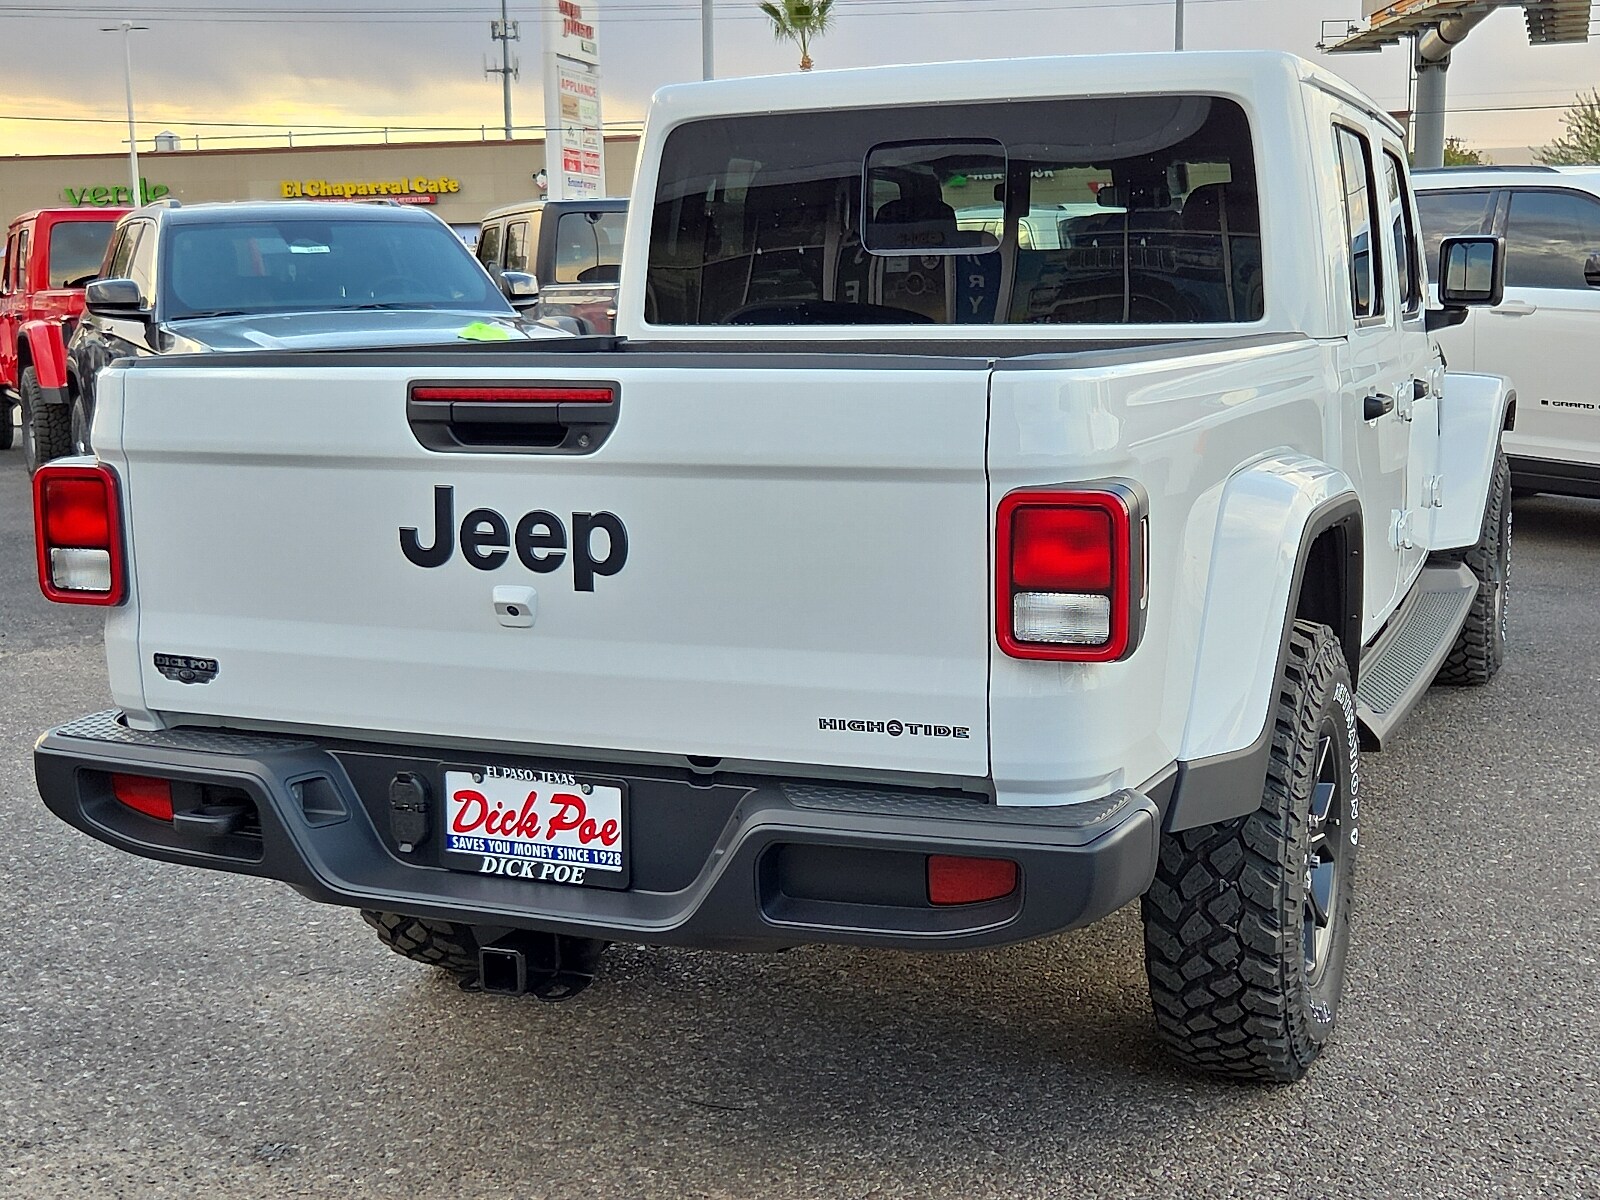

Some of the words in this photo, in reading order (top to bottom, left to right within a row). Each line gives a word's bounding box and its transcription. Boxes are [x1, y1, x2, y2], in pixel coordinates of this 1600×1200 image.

[63, 177, 170, 207] verde
[281, 180, 302, 198] El
[304, 177, 410, 198] Chaparral
[412, 176, 460, 194] Cafe
[1552, 401, 1595, 409] GRAND
[399, 484, 629, 593] Jeep
[156, 656, 187, 668] DICK
[190, 659, 216, 670] POE
[818, 717, 886, 733] HIGH
[904, 722, 971, 739] TIDE
[486, 766, 500, 779] EL
[540, 771, 577, 786] TEXAS
[452, 789, 542, 839] Dick
[545, 793, 621, 847] Poe
[452, 836, 486, 852] SAVES
[488, 840, 511, 854] YOU
[513, 842, 555, 859] MONEY
[557, 847, 590, 862] SINCE
[593, 850, 622, 866] 1928
[479, 856, 535, 879] DICK
[538, 862, 586, 885] POE
